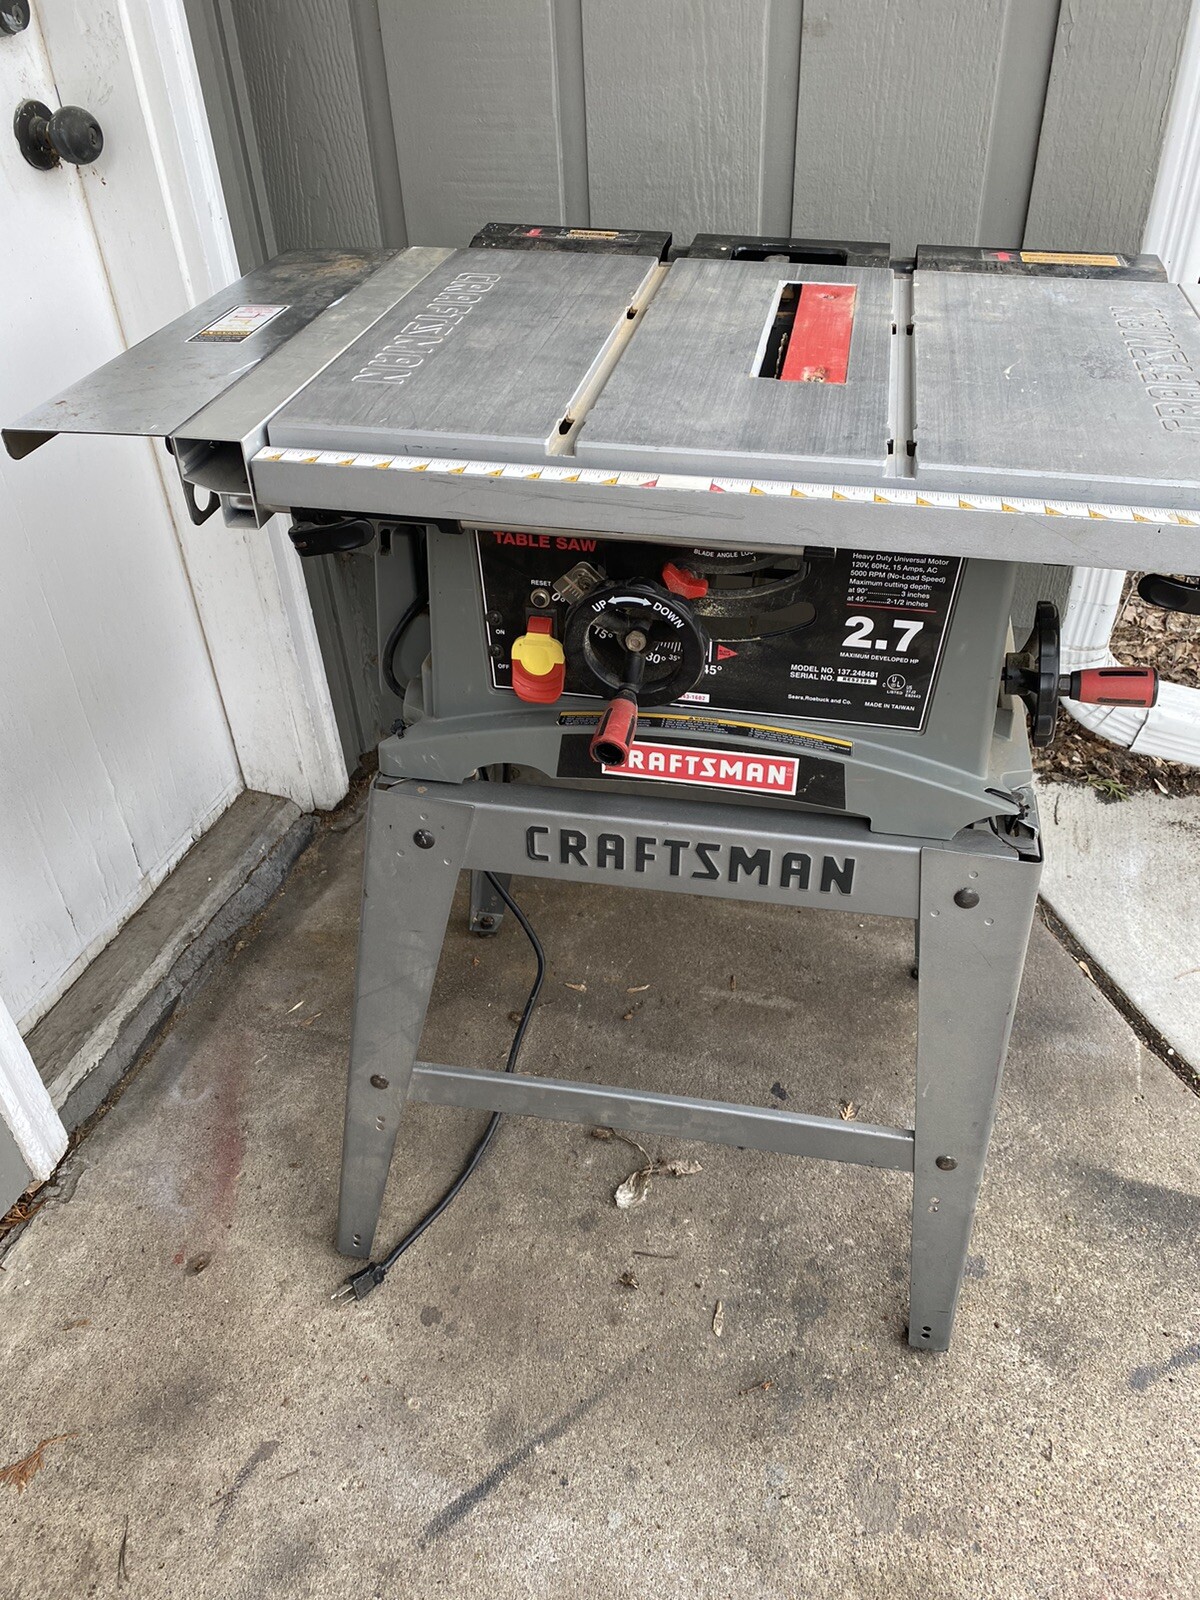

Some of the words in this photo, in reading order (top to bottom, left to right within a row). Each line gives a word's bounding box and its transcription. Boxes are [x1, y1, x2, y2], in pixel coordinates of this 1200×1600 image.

[351, 272, 501, 385] CRAFTSMAN
[493, 531, 550, 548] TABLE
[556, 536, 597, 552] SAW
[693, 548, 714, 557] BLADE
[852, 552, 874, 561] Heavy
[876, 554, 892, 562] Duty
[894, 555, 926, 564] Universal
[928, 558, 949, 566] Motor
[852, 561, 870, 569] 120V,
[871, 562, 891, 571] 60Hz,
[902, 565, 925, 573] Amps,
[530, 579, 551, 587] RESET
[887, 572, 920, 581] (No-Load
[921, 575, 946, 584] Speed)
[849, 578, 883, 587] Maximum
[884, 581, 908, 590] cutting
[909, 583, 932, 591] depth:
[907, 591, 930, 599] inches
[905, 599, 929, 608] inches
[591, 600, 607, 613] UP
[653, 602, 685, 629] DOWN
[842, 615, 924, 652] 2.7
[839, 651, 870, 661] MAXIMUM
[870, 654, 910, 663] DEVELOPED
[790, 664, 819, 673] MODEL
[789, 671, 819, 680] SERIAL
[621, 749, 786, 786] RAFTSMAN
[525, 825, 856, 895] CRAFTSMAN
